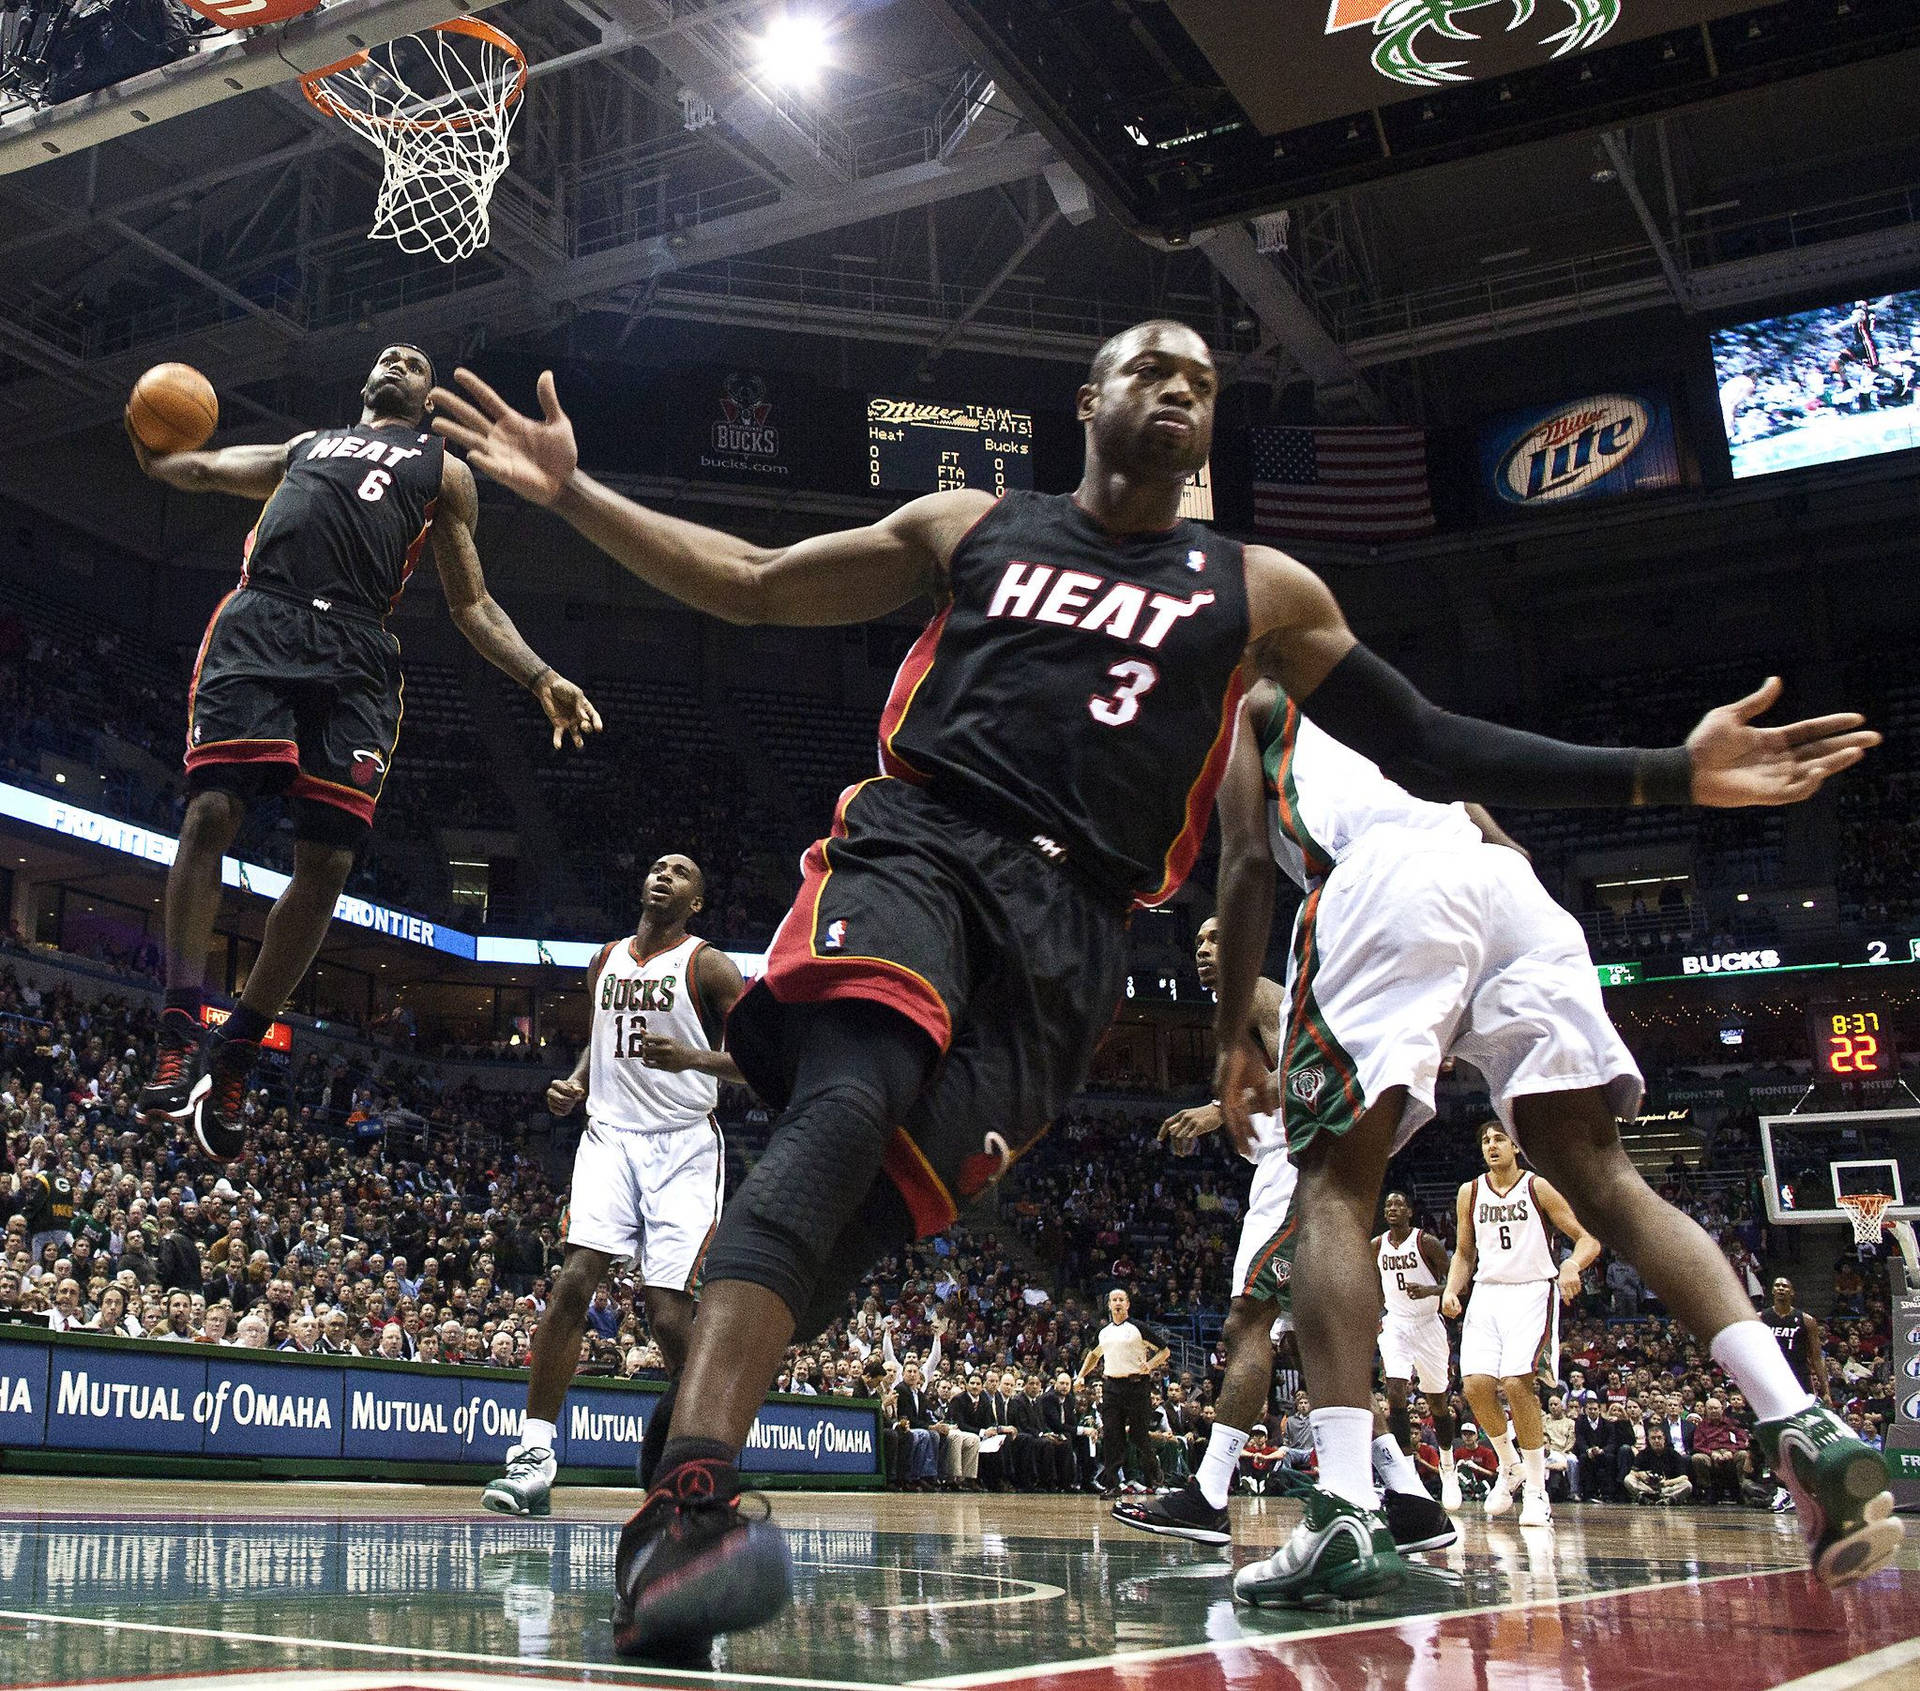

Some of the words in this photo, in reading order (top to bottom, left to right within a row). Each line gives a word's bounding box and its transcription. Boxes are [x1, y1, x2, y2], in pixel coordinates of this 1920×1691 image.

[966, 405, 1012, 420] TEAM
[1539, 408, 1610, 448] Miller
[717, 424, 775, 454] BUCKS
[869, 427, 905, 442] Heat
[306, 435, 423, 468] HEAT
[700, 455, 790, 475] bucks.com
[869, 445, 879, 457] 0
[941, 451, 960, 465] FT
[994, 458, 1004, 471] 0
[356, 468, 393, 502] 6
[870, 460, 880, 472] 0
[938, 465, 965, 480] FTA
[995, 472, 1005, 485] 0
[870, 473, 880, 486] 0
[986, 560, 1216, 650] HEAT
[1087, 657, 1160, 727] 3
[333, 895, 435, 947] FRONTIER
[1682, 949, 1781, 975] BUCKS
[1867, 940, 1890, 963] 2
[600, 973, 677, 1012] BUCKS
[614, 1015, 647, 1058] 12
[1832, 1012, 1880, 1035] 8:37
[1829, 1034, 1879, 1073] 22
[1478, 1199, 1529, 1224] BUCKS
[1499, 1226, 1512, 1250] 6
[1382, 1251, 1419, 1272] BUCKS
[1396, 1272, 1407, 1291] 8
[1788, 1338, 1794, 1350] 1
[57, 1371, 185, 1421] MUTUAL
[193, 1381, 231, 1435] of
[233, 1384, 332, 1429] OMAHA
[352, 1391, 448, 1434] MUTUAL
[453, 1397, 480, 1444] of
[571, 1405, 644, 1443] MUTUAL
[746, 1417, 805, 1451] MUTUAL
[807, 1420, 824, 1459] of
[824, 1422, 872, 1453] OMAHA
